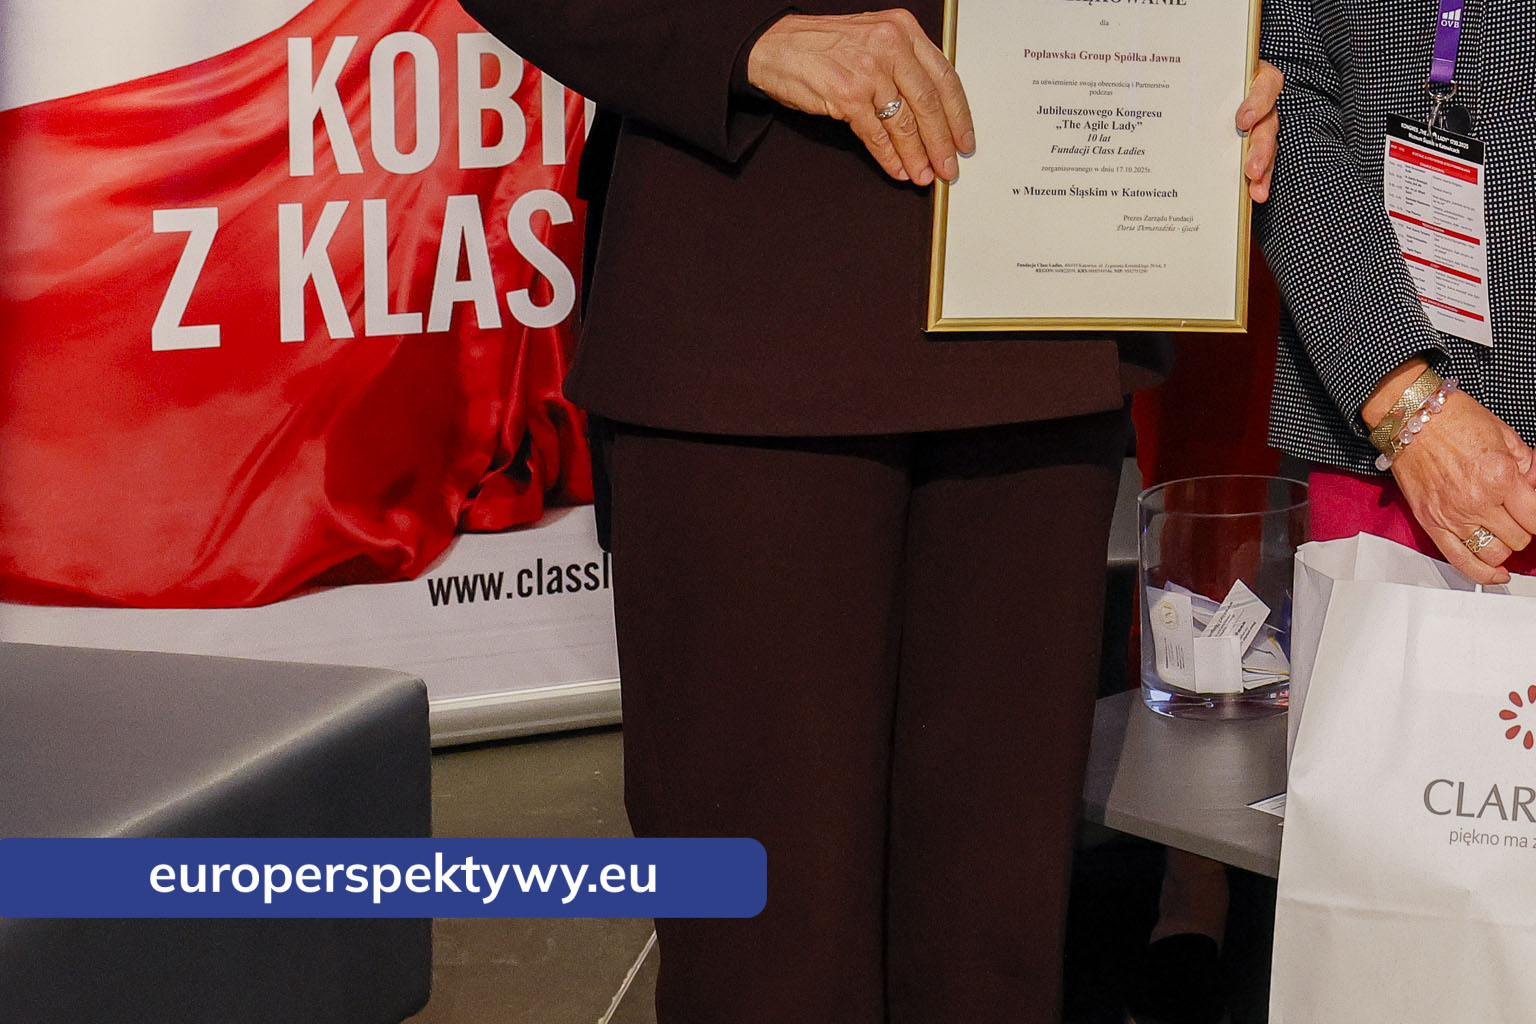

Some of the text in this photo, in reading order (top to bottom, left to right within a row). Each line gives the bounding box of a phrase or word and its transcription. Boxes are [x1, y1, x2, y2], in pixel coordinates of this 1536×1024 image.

[1440, 19, 1460, 29] OVB
[1079, 50, 1111, 63] Group
[1149, 53, 1181, 63] Jawna
[287, 31, 596, 177] KOBI
[1036, 105, 1162, 118] Jubileuszowego Kongresu
[1084, 120, 1109, 131] Agile
[1087, 133, 1112, 142] 10 lat
[1050, 145, 1146, 156] Fundacji Class Ladies
[1012, 188, 1021, 196] w
[1024, 186, 1067, 196] Muzeum
[1069, 184, 1108, 198] Śląskim
[1121, 187, 1178, 198] Katowicach
[1168, 215, 1194, 223] Fundacji
[151, 189, 576, 352] Z KLAS
[427, 552, 610, 607] www.classl
[1449, 827, 1500, 846] piękno
[1504, 834, 1528, 848] ma
